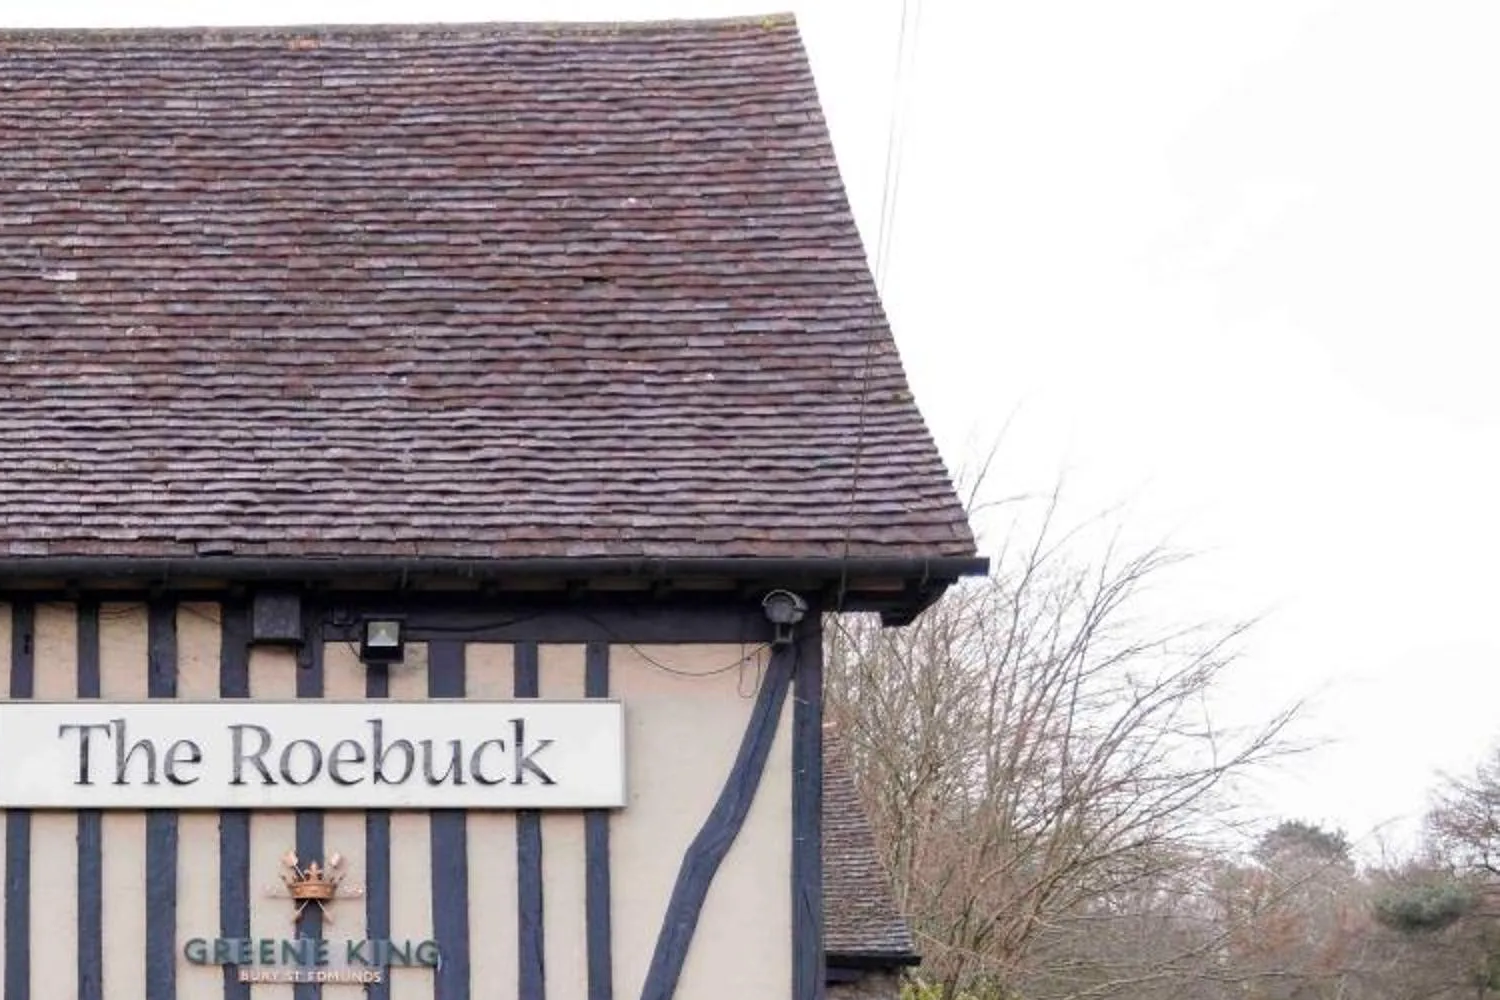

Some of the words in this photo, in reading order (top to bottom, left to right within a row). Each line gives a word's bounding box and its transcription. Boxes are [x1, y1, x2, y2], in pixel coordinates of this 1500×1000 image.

[58, 718, 202, 787] The
[227, 718, 557, 787] Roebuck
[184, 938, 329, 966] GREENE
[346, 937, 440, 968] KING
